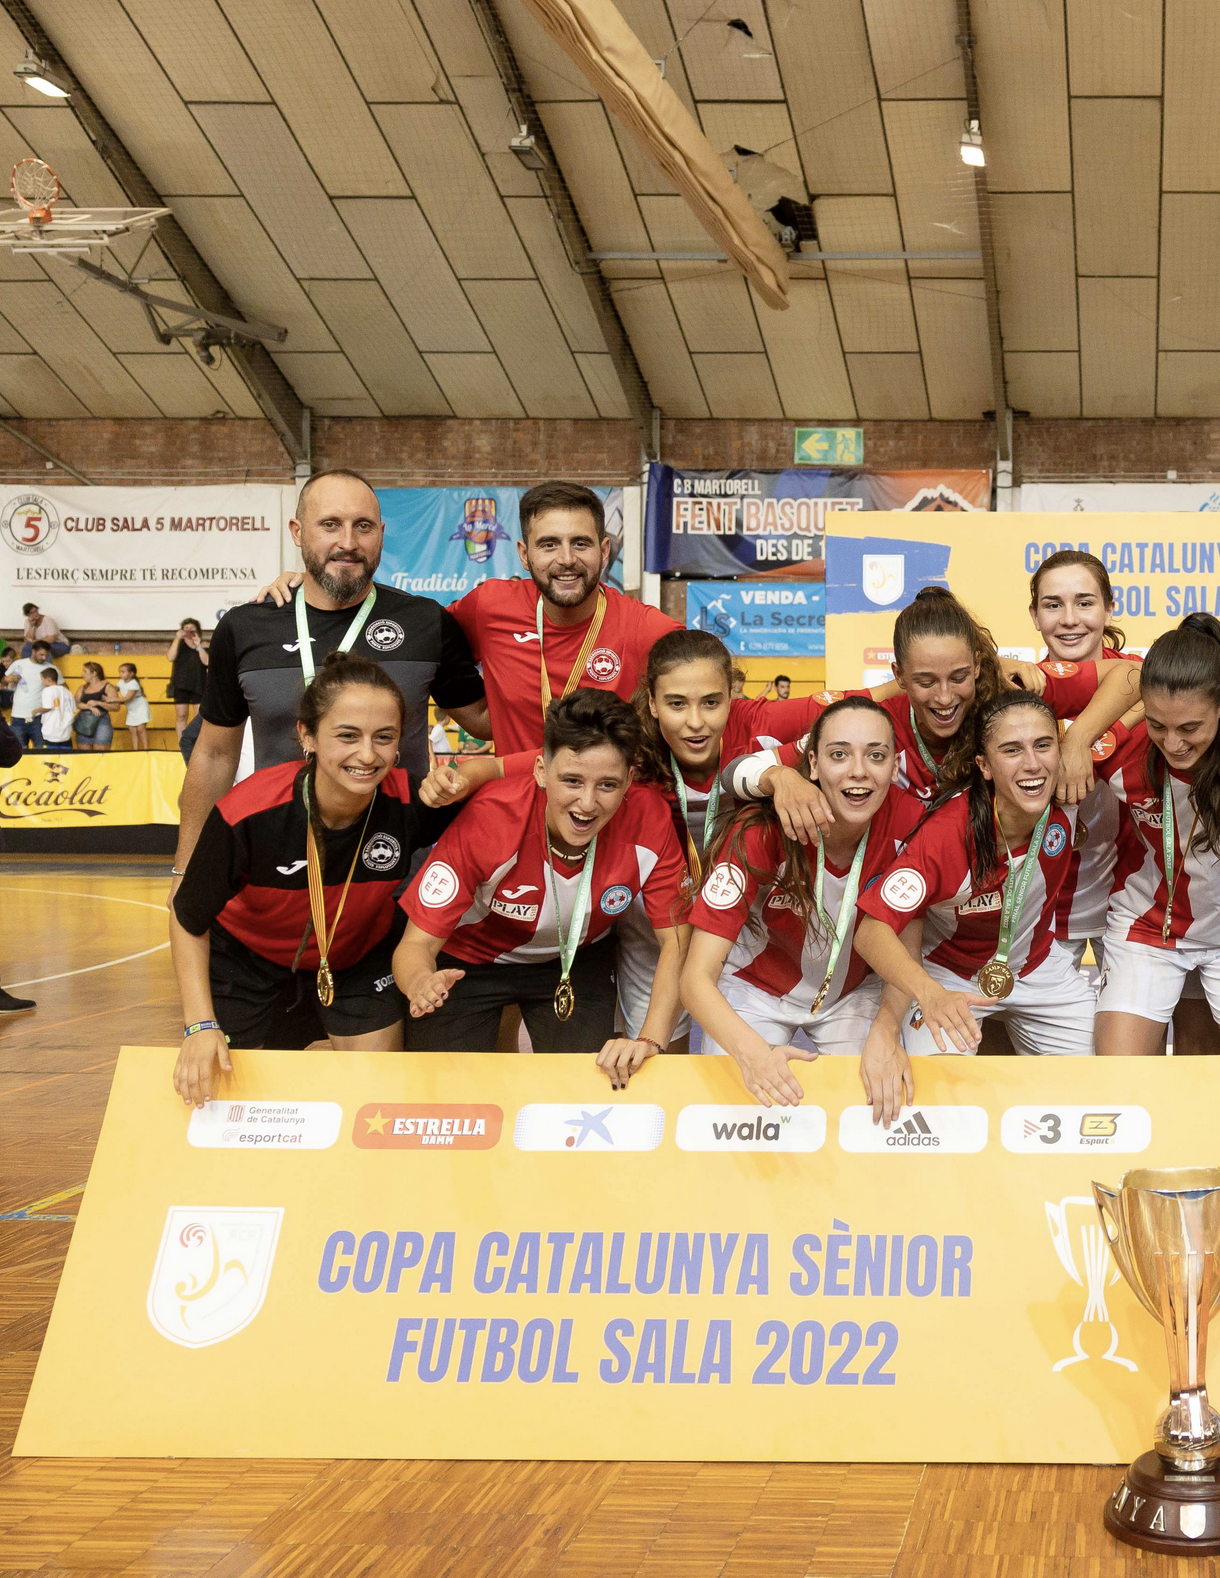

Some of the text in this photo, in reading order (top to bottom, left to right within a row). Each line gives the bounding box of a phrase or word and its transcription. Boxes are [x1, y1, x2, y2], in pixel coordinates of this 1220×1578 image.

[673, 478, 761, 495] C B MARTORELL
[64, 515, 270, 532] CLUB SALA 5 MARTORELL
[673, 497, 863, 537] FENT BASQU
[21, 516, 42, 543] 5
[756, 539, 788, 561] DES
[791, 539, 812, 561] DE
[16, 565, 257, 584] L'ESFORÇ SEMPRE TÉ RECOMPENSA
[391, 572, 468, 592] Tradició
[740, 590, 807, 605] VENDA
[741, 611, 826, 626] La Secre
[710, 787, 718, 811] SENIOR
[847, 875, 856, 898] FUTBOL
[853, 855, 862, 873] SALA
[1011, 824, 1045, 923] FINAL SENIOR FUTBOL SALA 2022
[580, 871, 591, 897] FUTBOL
[493, 899, 531, 917] PLAY
[574, 899, 585, 922] SENIOR
[571, 922, 579, 939] FINAL
[1002, 915, 1010, 929] 2022
[249, 1106, 299, 1115] Generalitat
[246, 1115, 306, 1126] de Catalunya
[392, 1118, 487, 1137] ESTRELLA
[712, 1115, 781, 1142] wala
[1039, 1113, 1062, 1145] 3
[239, 1132, 303, 1146] esportcat
[421, 1135, 455, 1146] DAMM
[886, 1131, 941, 1147] adidas
[317, 1217, 974, 1298] COPA CATALUNYA SÈNIOR
[385, 1316, 900, 1386] FUTBOL SALA 2022
